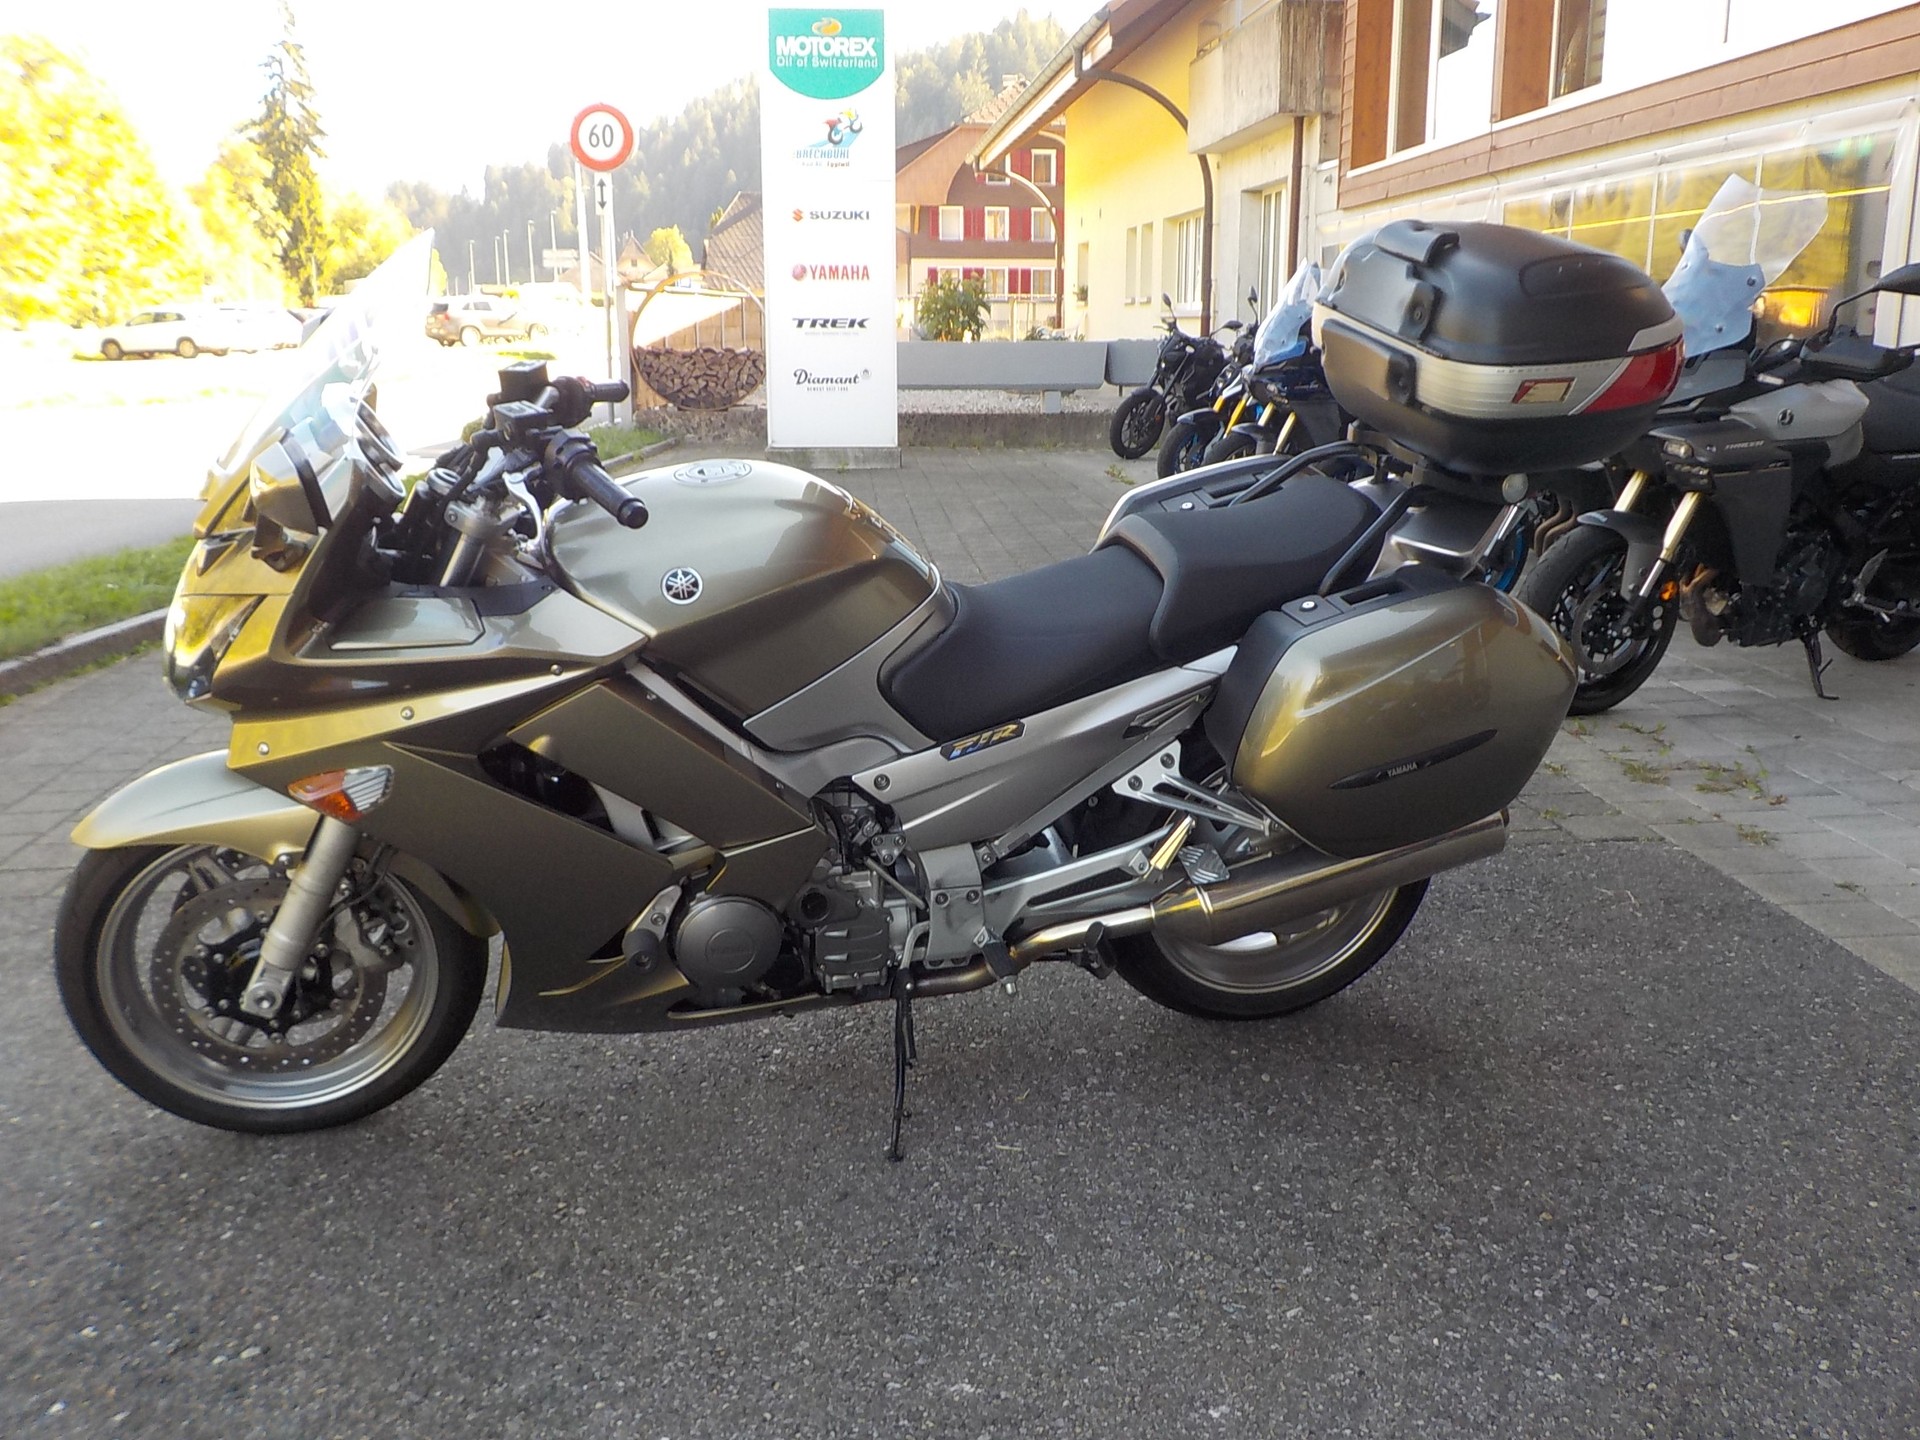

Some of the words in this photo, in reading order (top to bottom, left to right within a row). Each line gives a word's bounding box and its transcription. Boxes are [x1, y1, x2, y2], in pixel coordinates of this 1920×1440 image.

[776, 35, 877, 57] MOTOREX
[776, 56, 792, 67] Oil
[796, 56, 808, 68] of
[812, 56, 878, 68] Switzerland
[588, 123, 614, 148] 60
[809, 210, 870, 220] SUZUKI
[809, 264, 870, 281] YAMAHA
[792, 318, 870, 328] TREK
[793, 368, 860, 385] Diamant
[1387, 761, 1418, 778] YAMAHA
